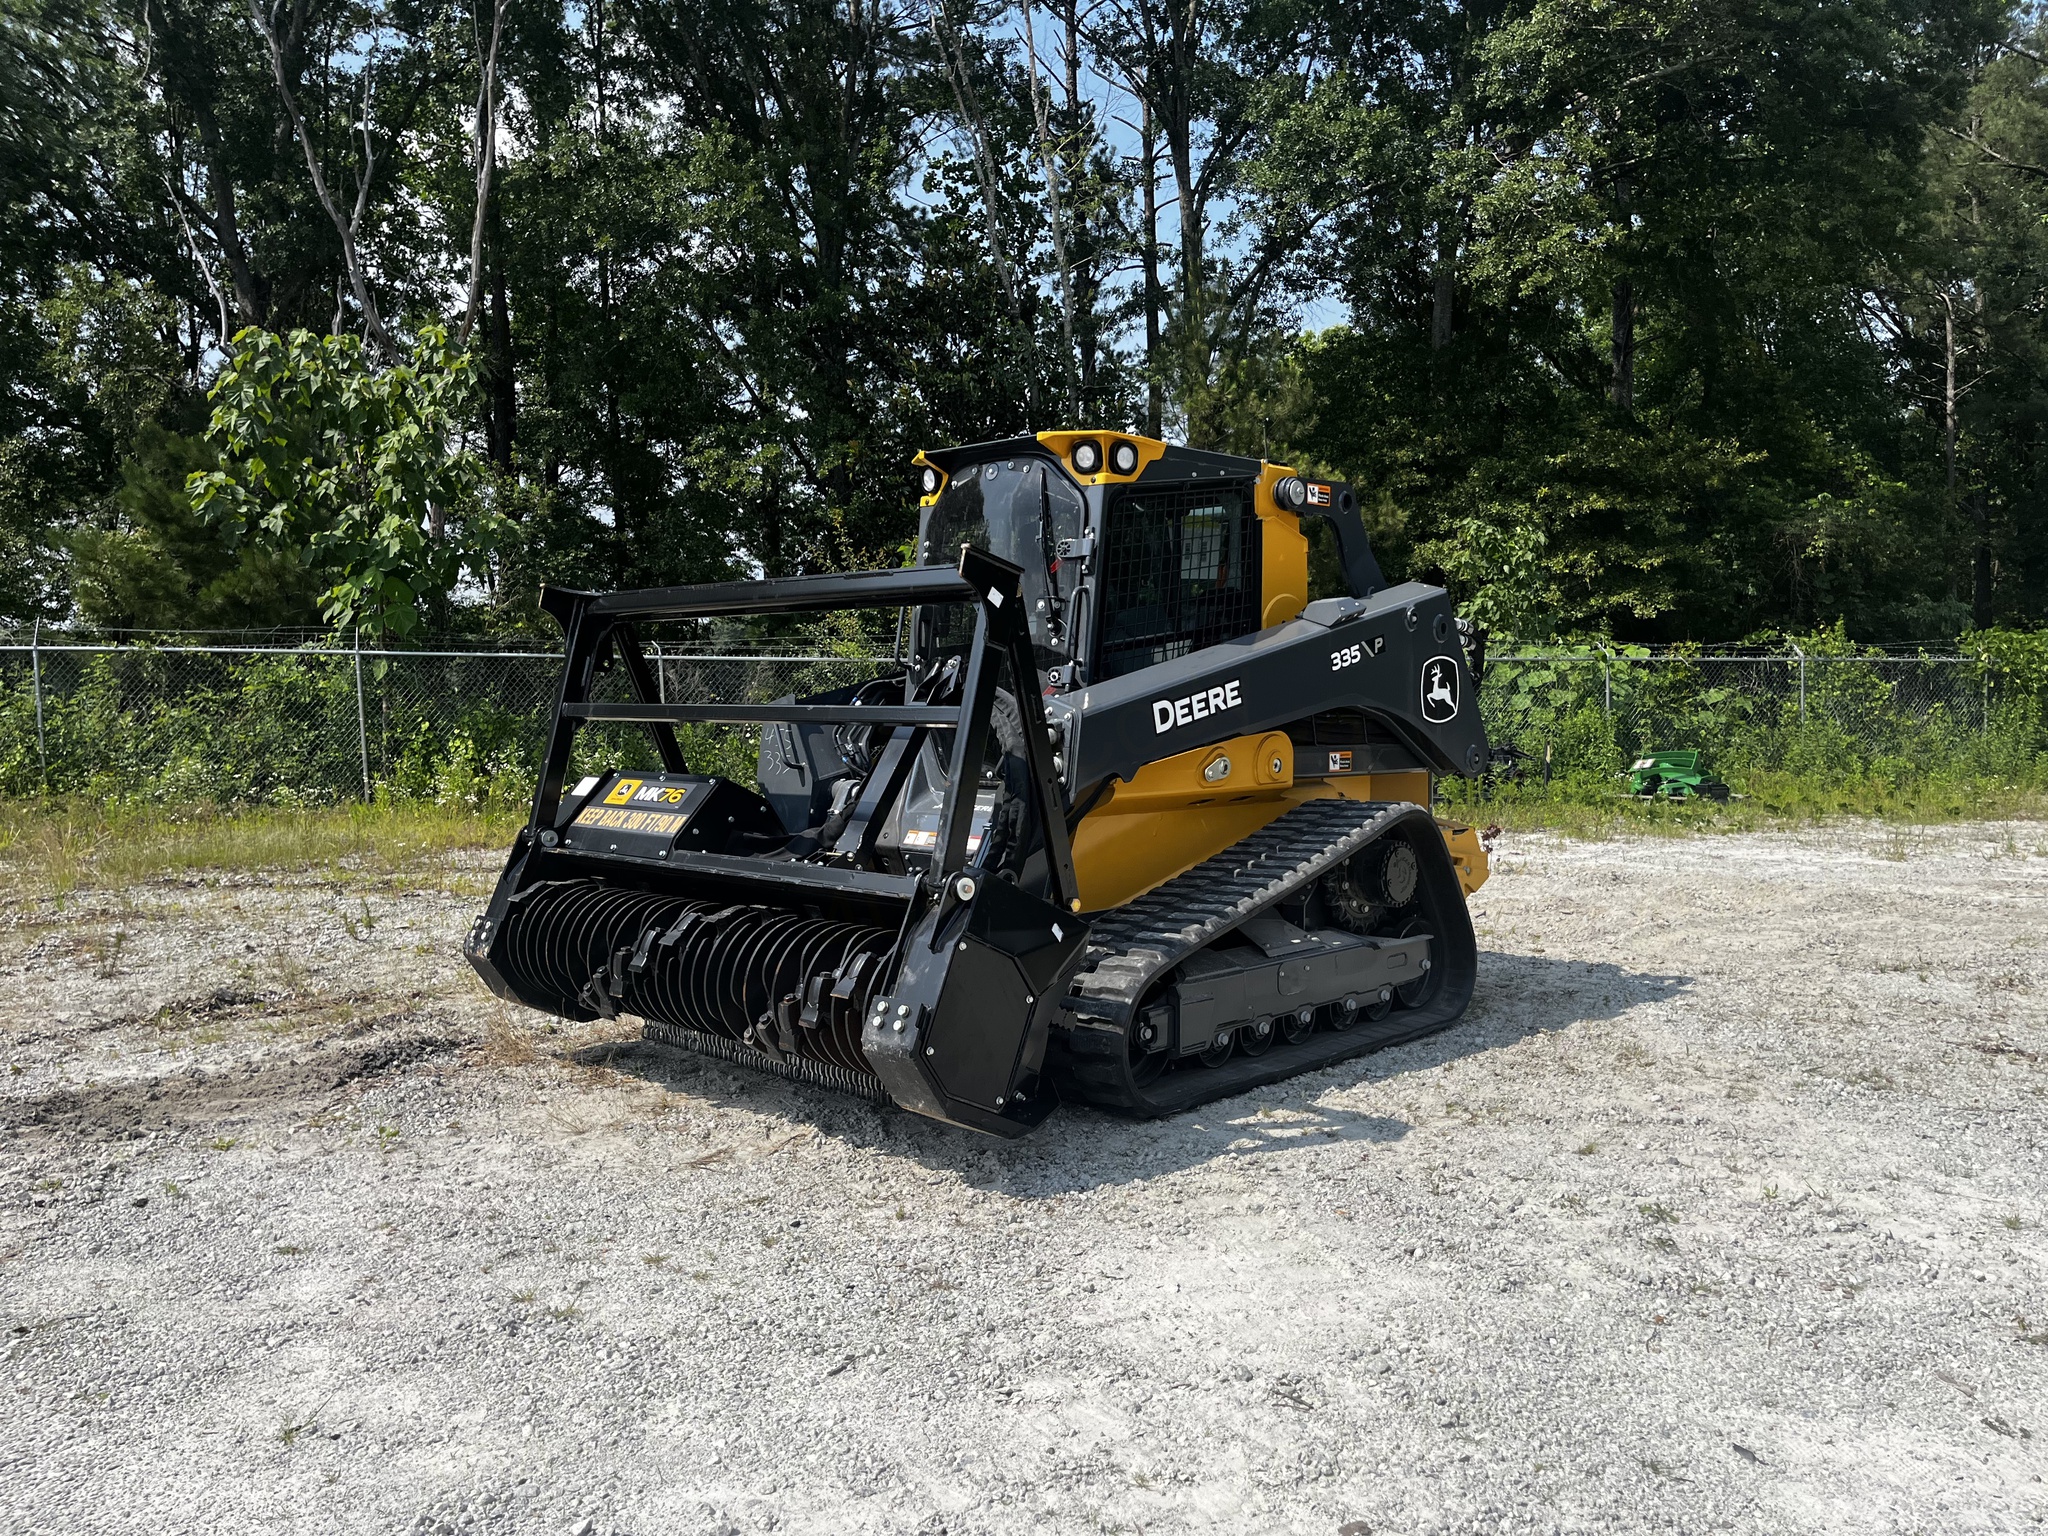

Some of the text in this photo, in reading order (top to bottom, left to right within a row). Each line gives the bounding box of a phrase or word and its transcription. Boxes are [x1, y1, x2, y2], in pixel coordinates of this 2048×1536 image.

[1330, 644, 1362, 671] 335
[1152, 679, 1242, 734] DEERE
[634, 786, 686, 804] MK76
[574, 807, 688, 834] KEEP BACK 300 FT/90 M
